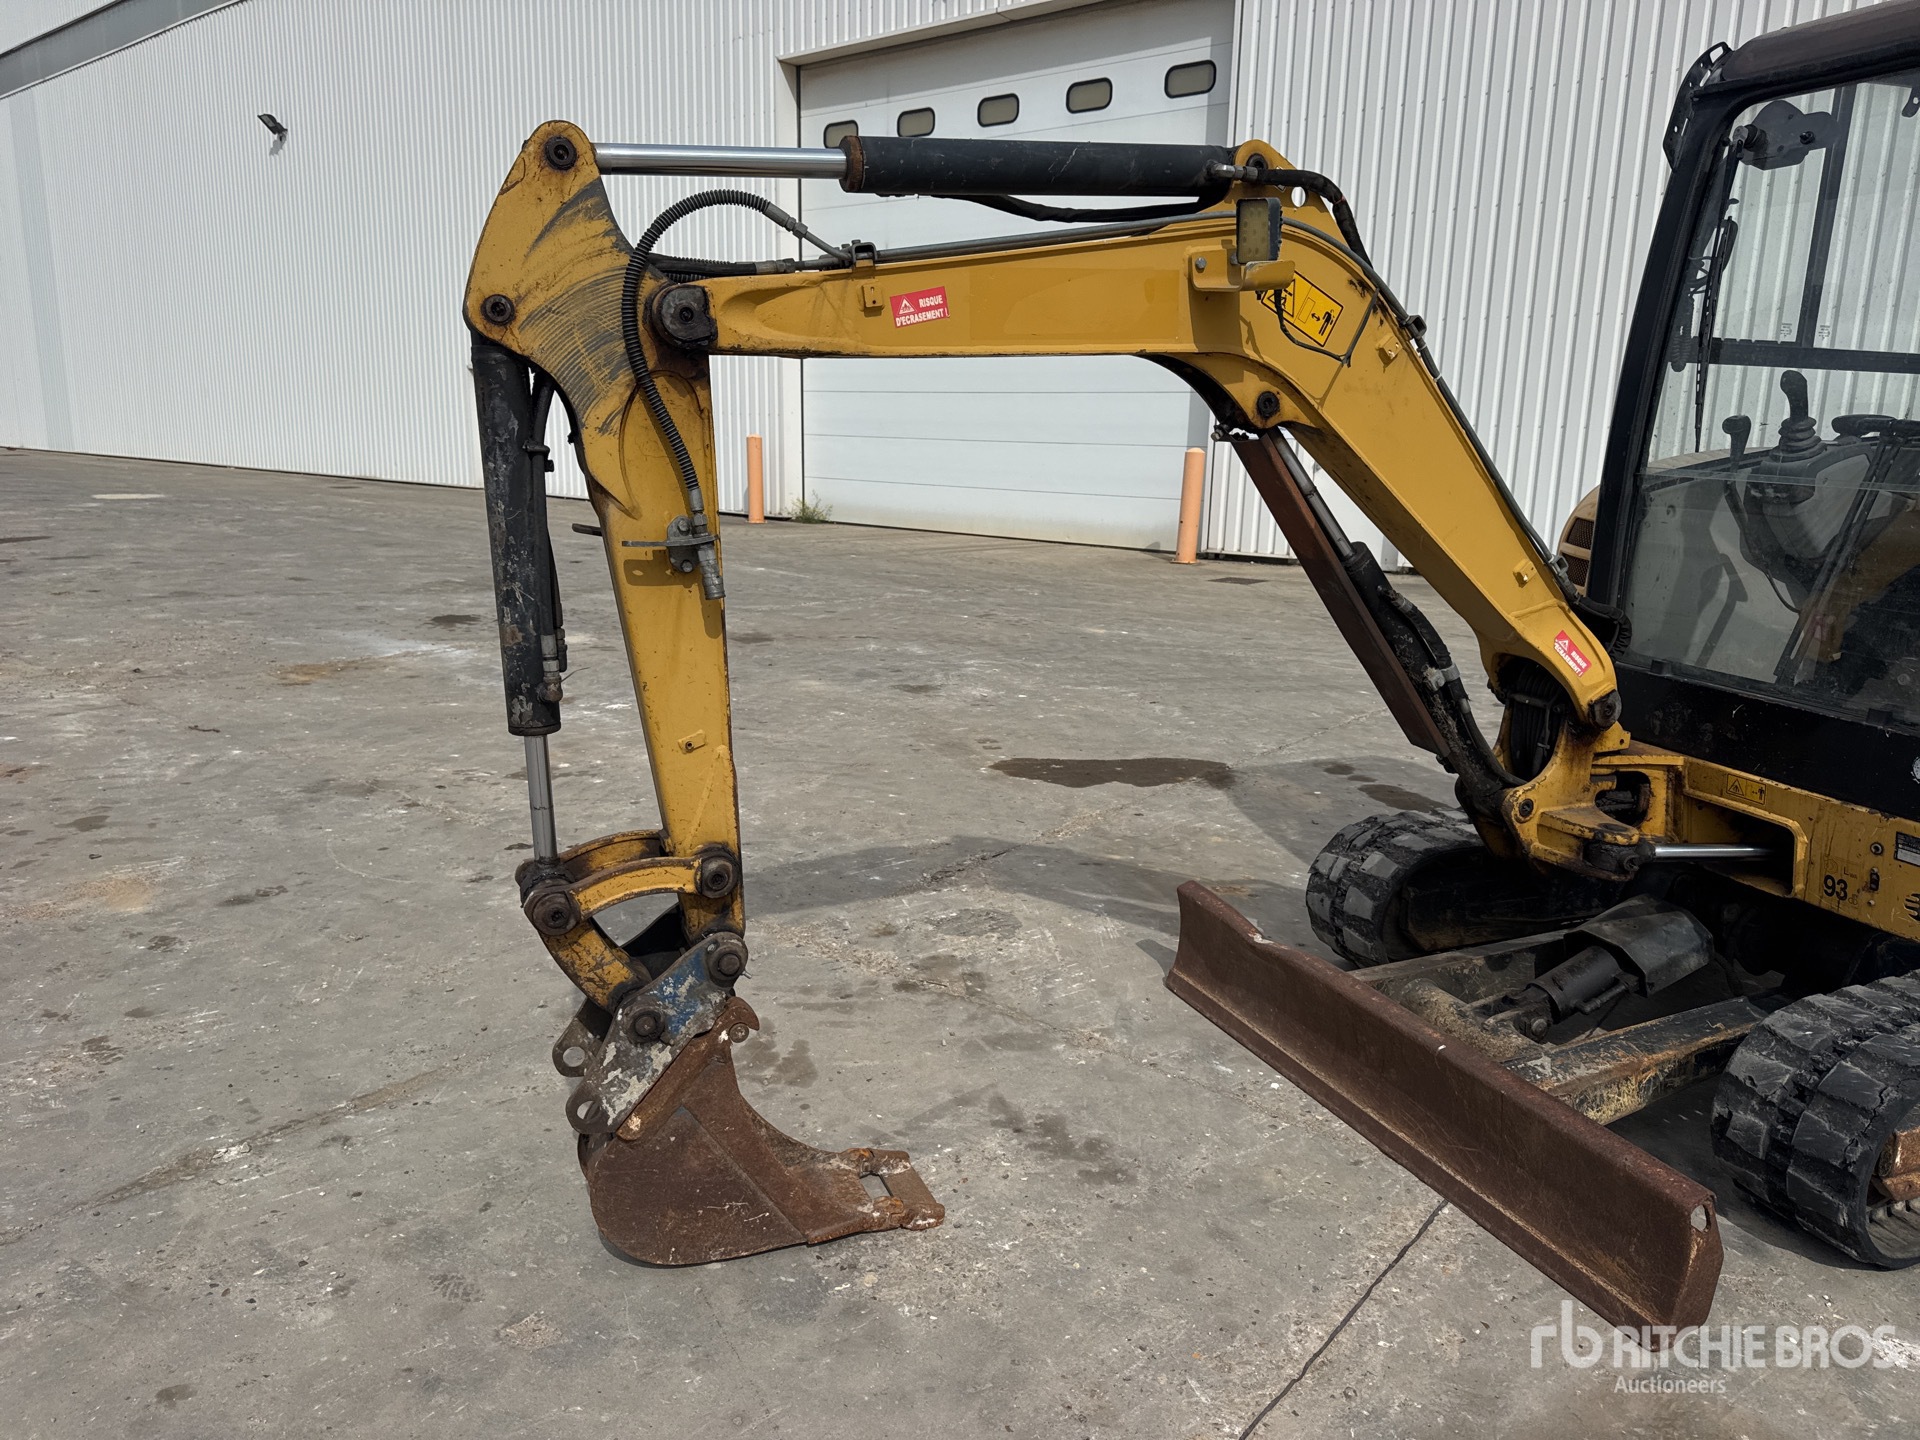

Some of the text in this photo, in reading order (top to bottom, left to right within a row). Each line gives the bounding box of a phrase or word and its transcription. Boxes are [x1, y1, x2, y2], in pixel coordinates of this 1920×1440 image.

[918, 294, 944, 308] RISQUE
[895, 308, 944, 327] D'ECRASEMENT
[1570, 650, 1588, 669] RISQUE
[1823, 874, 1848, 901] 93
